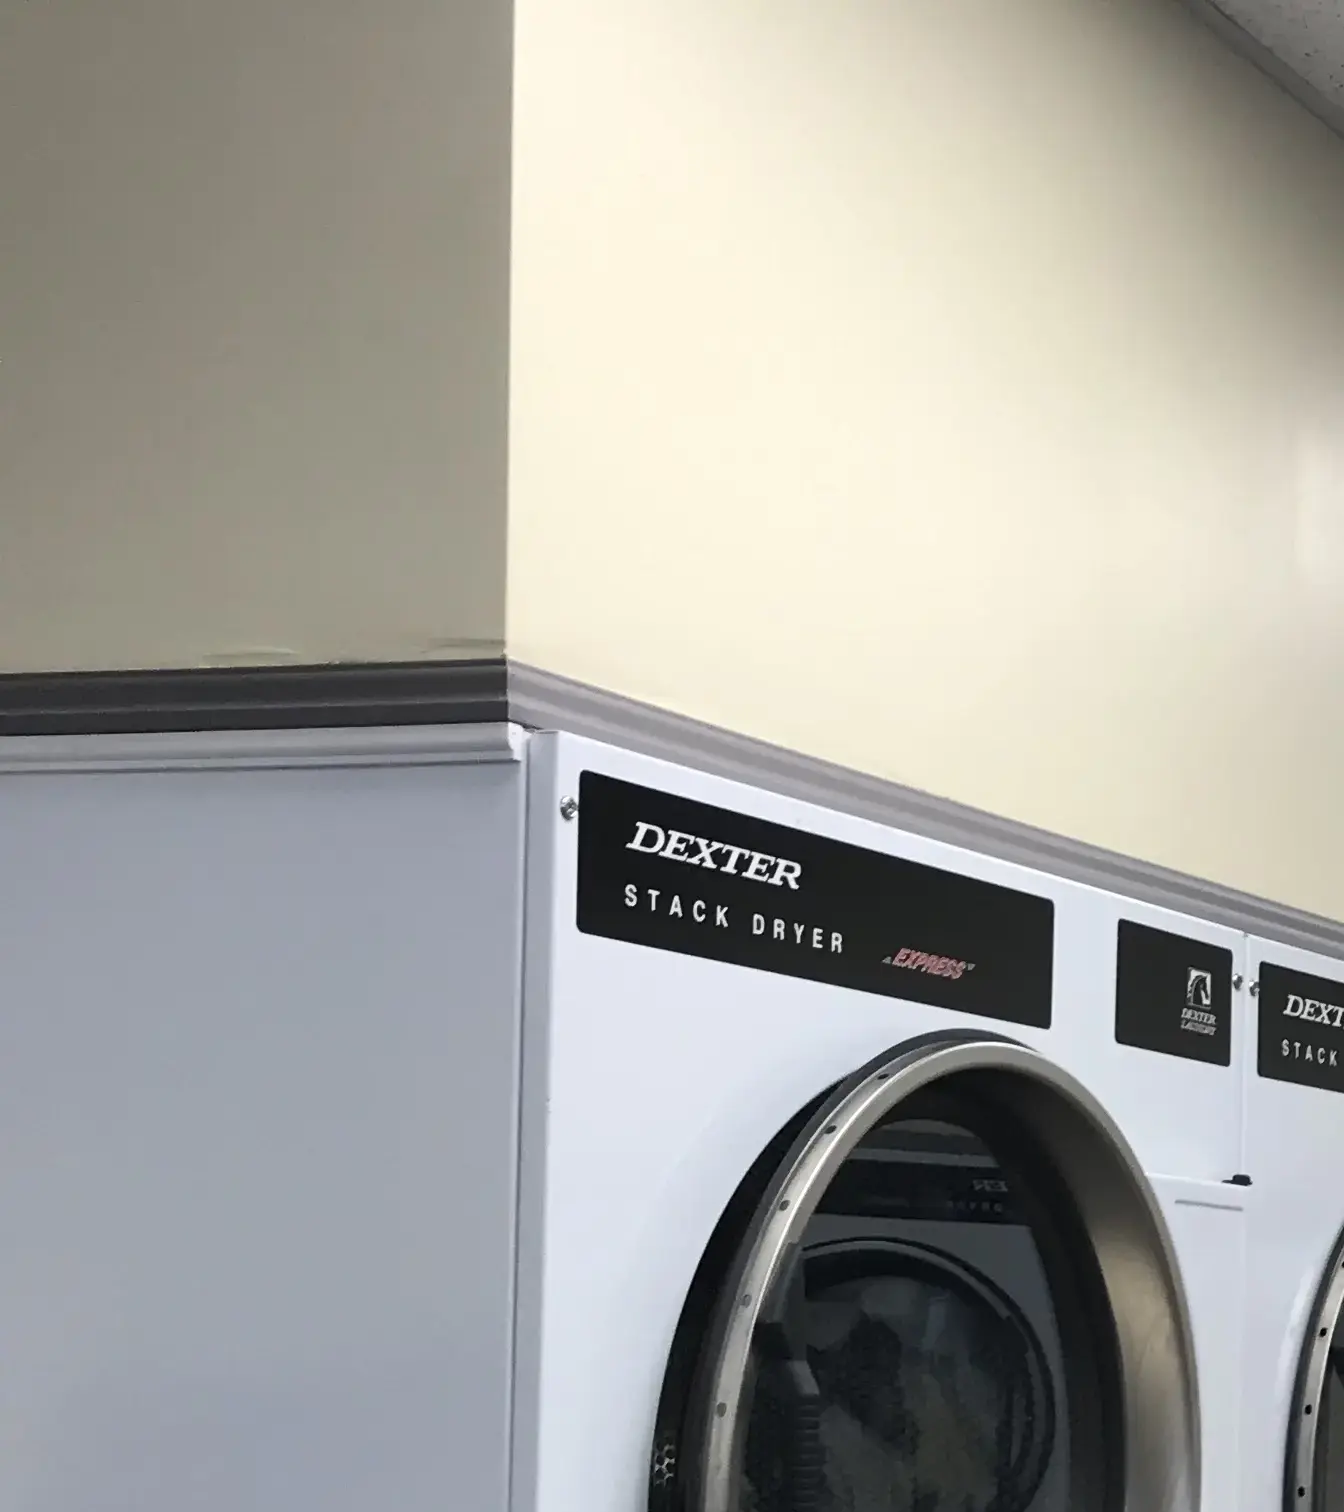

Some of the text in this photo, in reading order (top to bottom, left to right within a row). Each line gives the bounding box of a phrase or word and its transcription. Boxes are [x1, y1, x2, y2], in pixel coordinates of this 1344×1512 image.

[625, 821, 803, 890] DEXTER
[624, 883, 843, 954] STACK DRYER
[892, 947, 967, 980] EXPRESS
[1281, 1038, 1337, 1068] STACK
